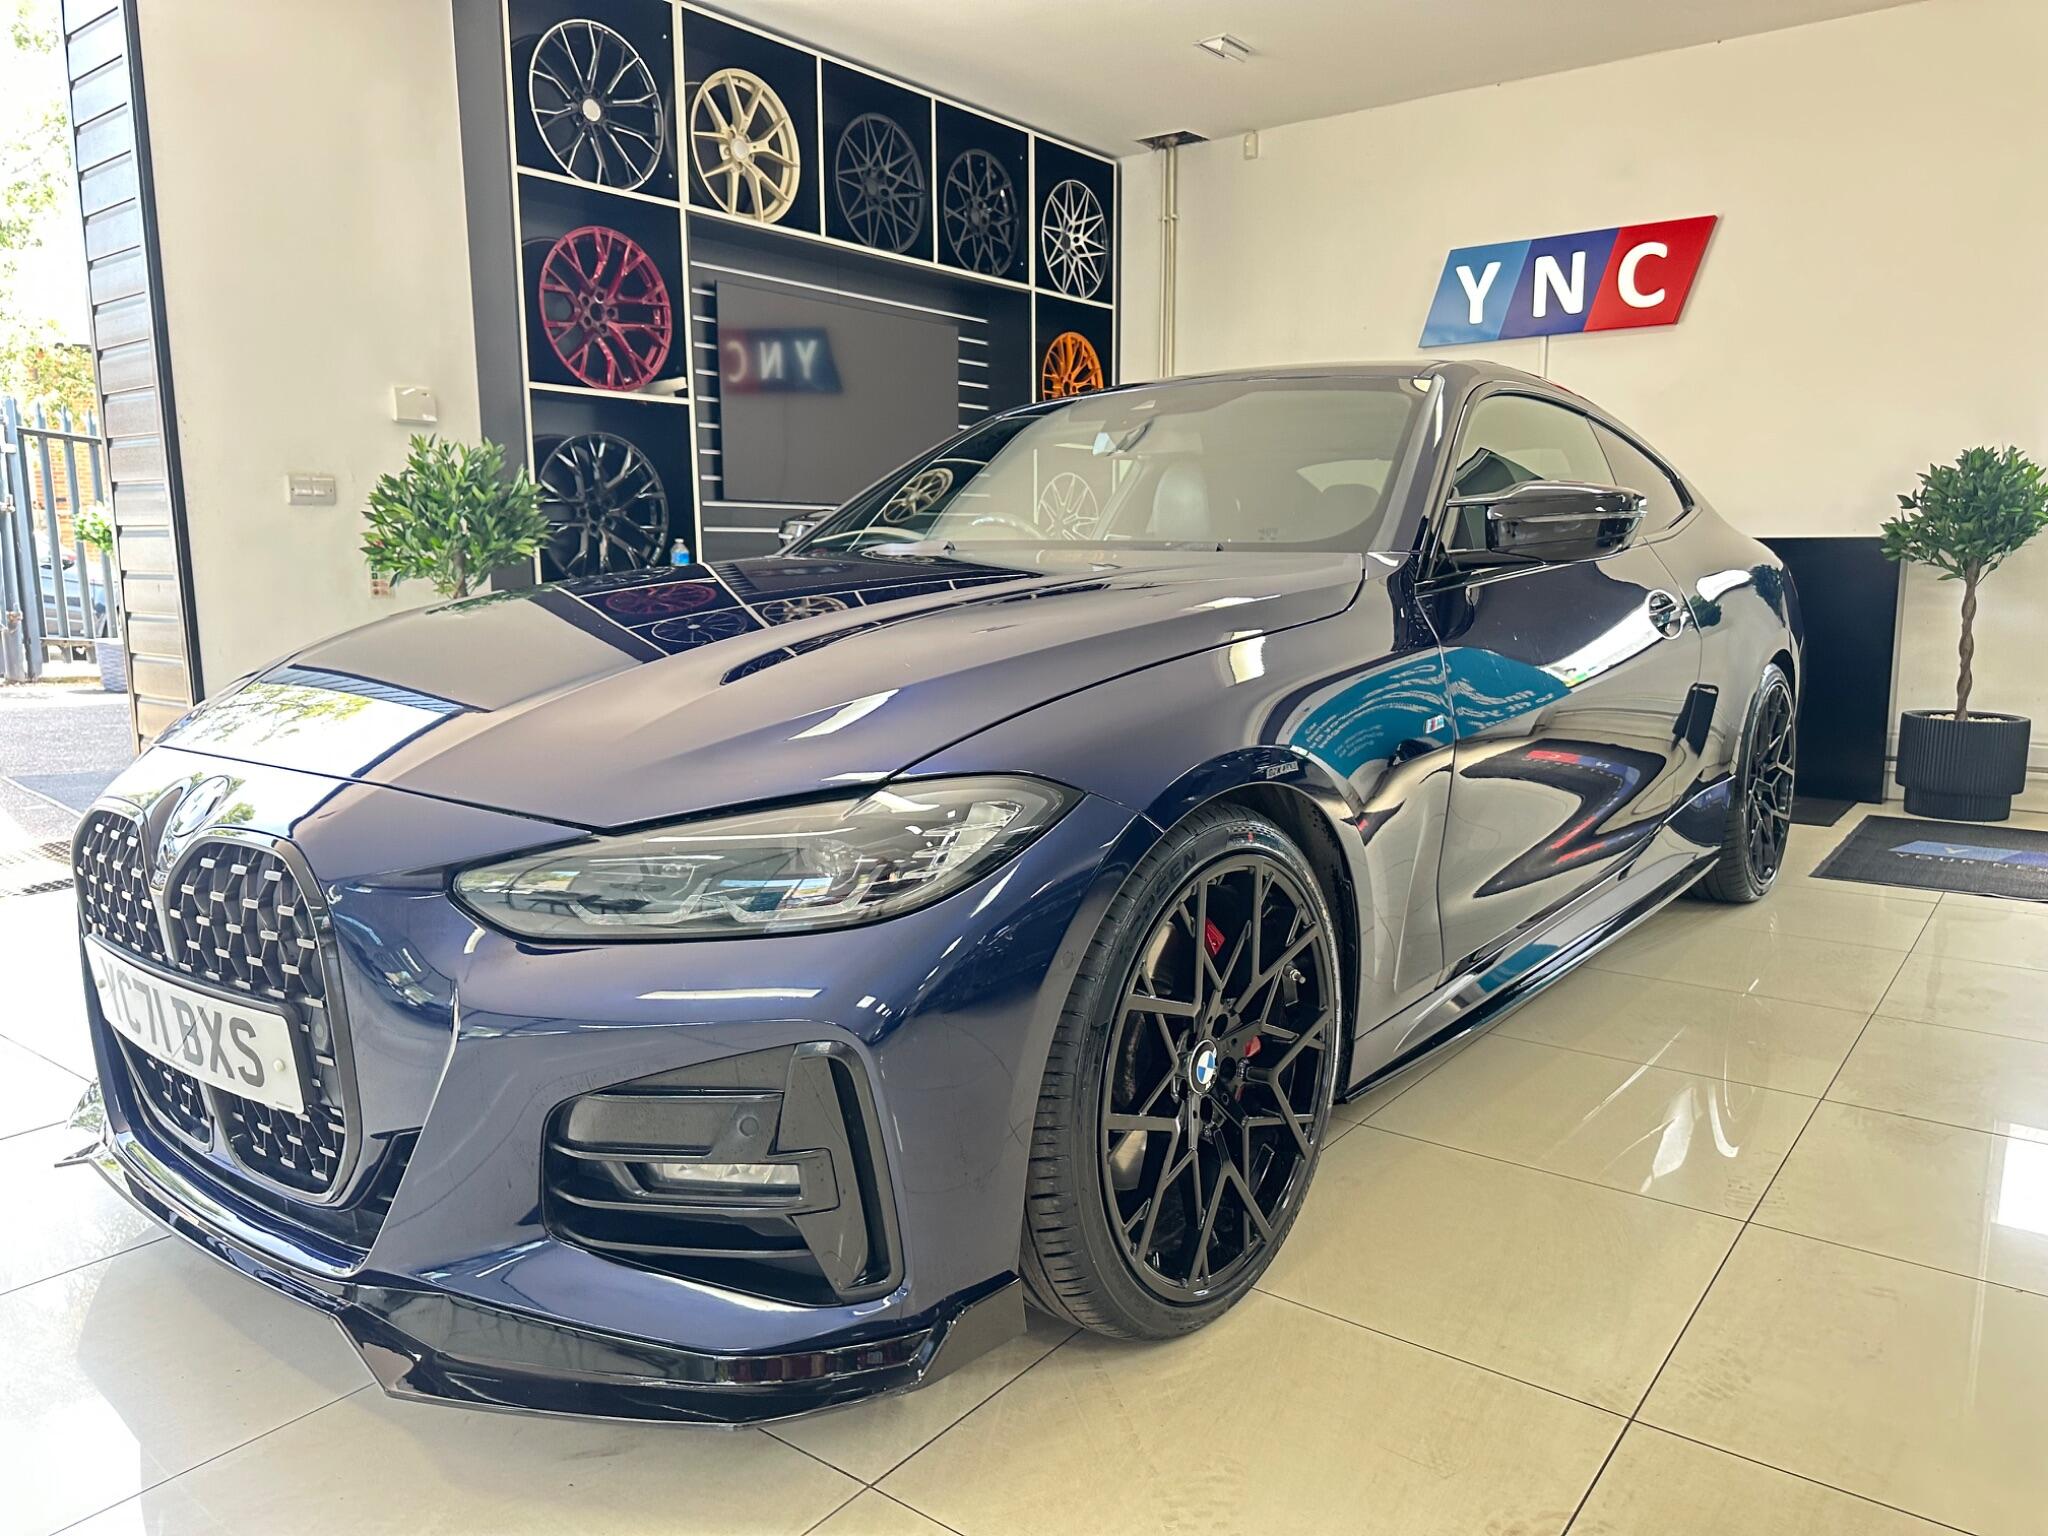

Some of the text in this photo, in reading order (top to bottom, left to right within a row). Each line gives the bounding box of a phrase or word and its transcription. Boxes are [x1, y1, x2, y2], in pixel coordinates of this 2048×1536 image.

[1455, 241, 1668, 325] YNC
[99, 956, 265, 1088] YC71 BXS
